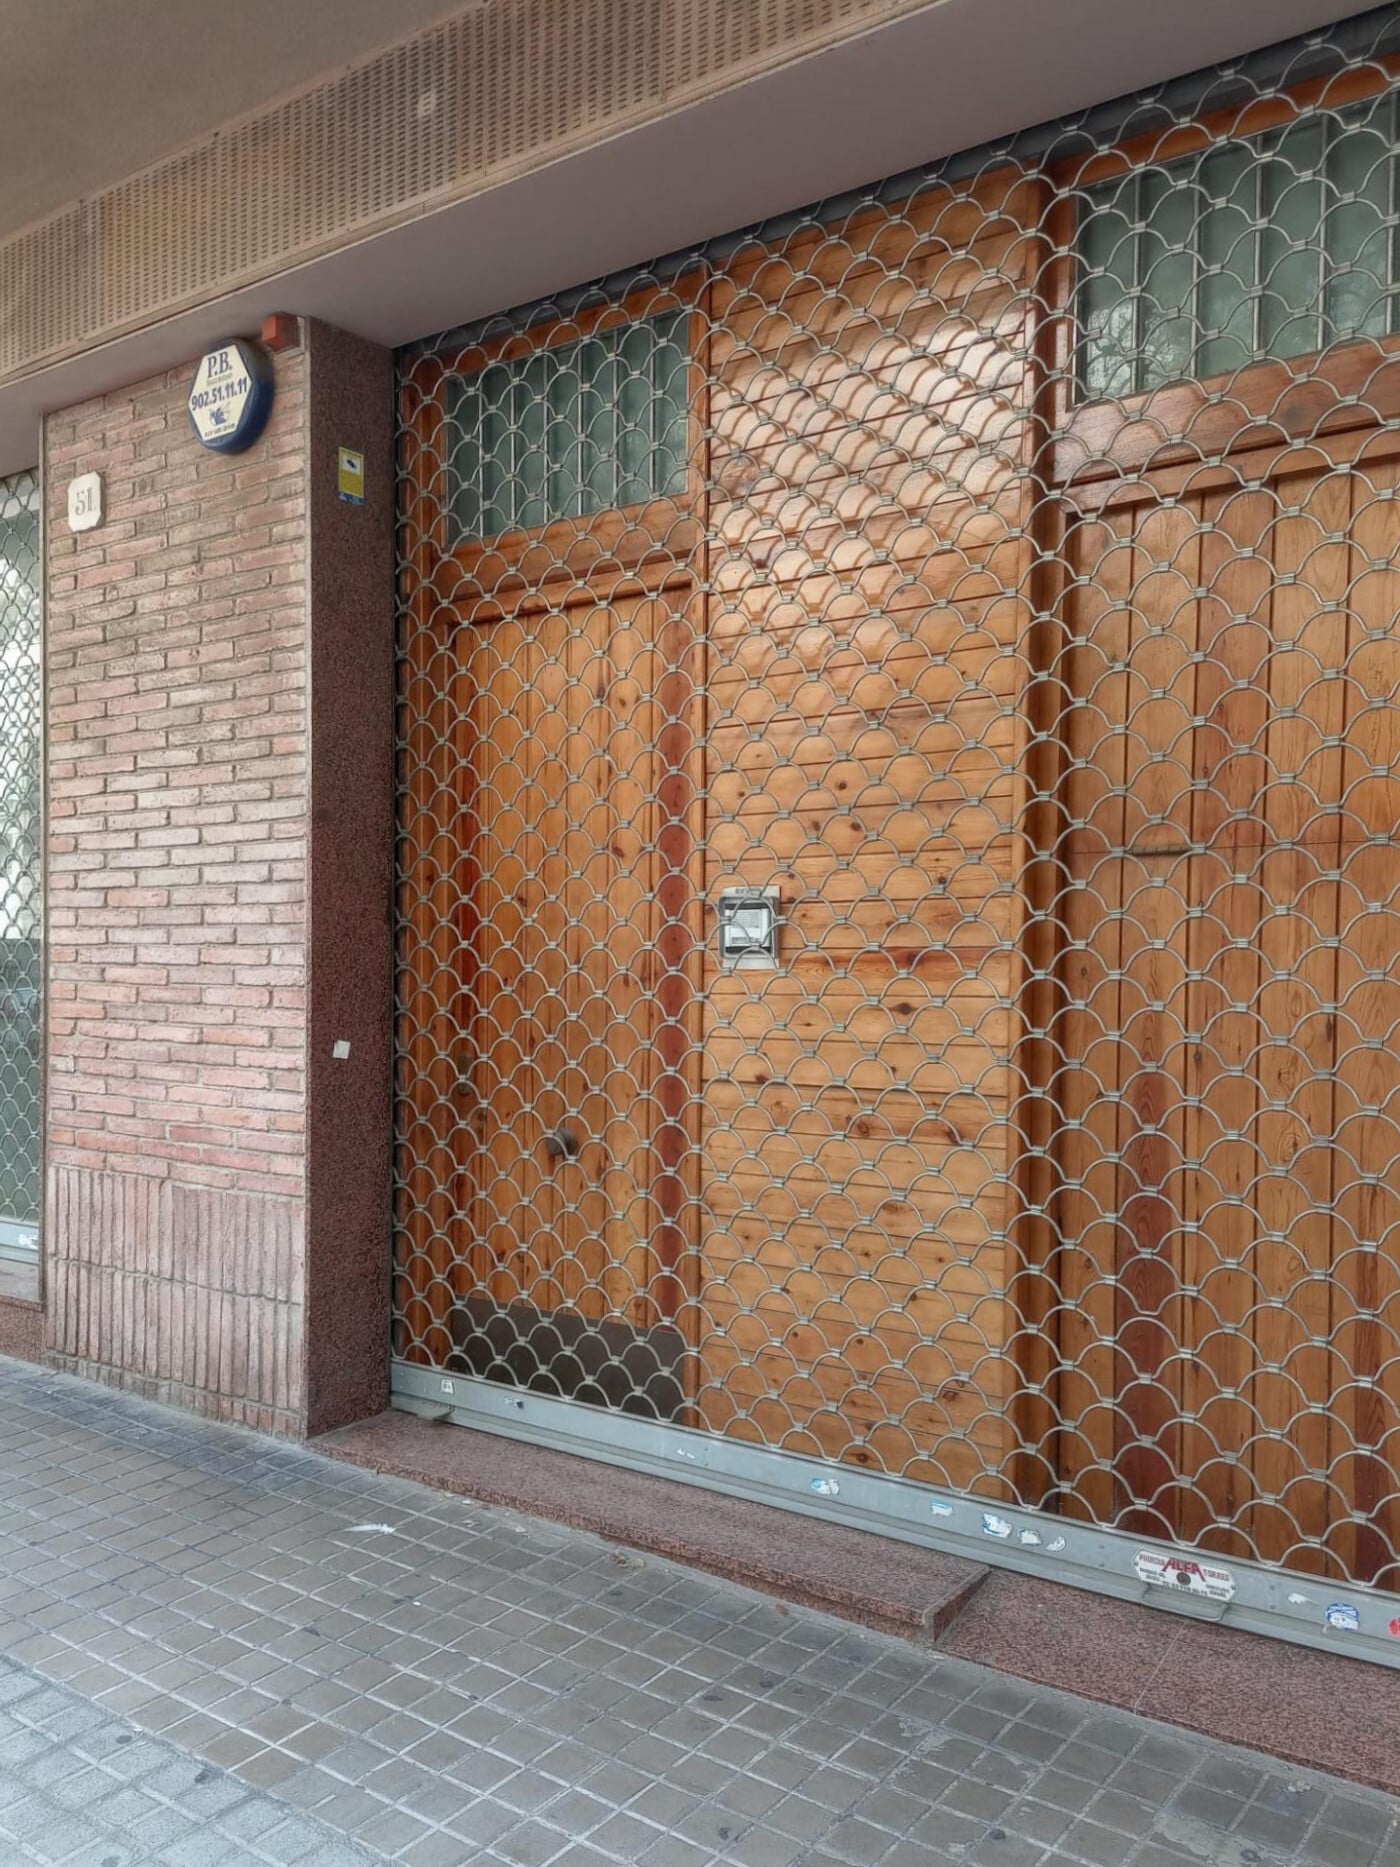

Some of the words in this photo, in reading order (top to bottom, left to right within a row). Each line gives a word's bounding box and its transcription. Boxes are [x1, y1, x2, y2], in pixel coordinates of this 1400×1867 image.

[207, 351, 233, 378] P.B.
[191, 376, 248, 411] 902.51.11.11
[1161, 1557, 1206, 1582] ALFA
